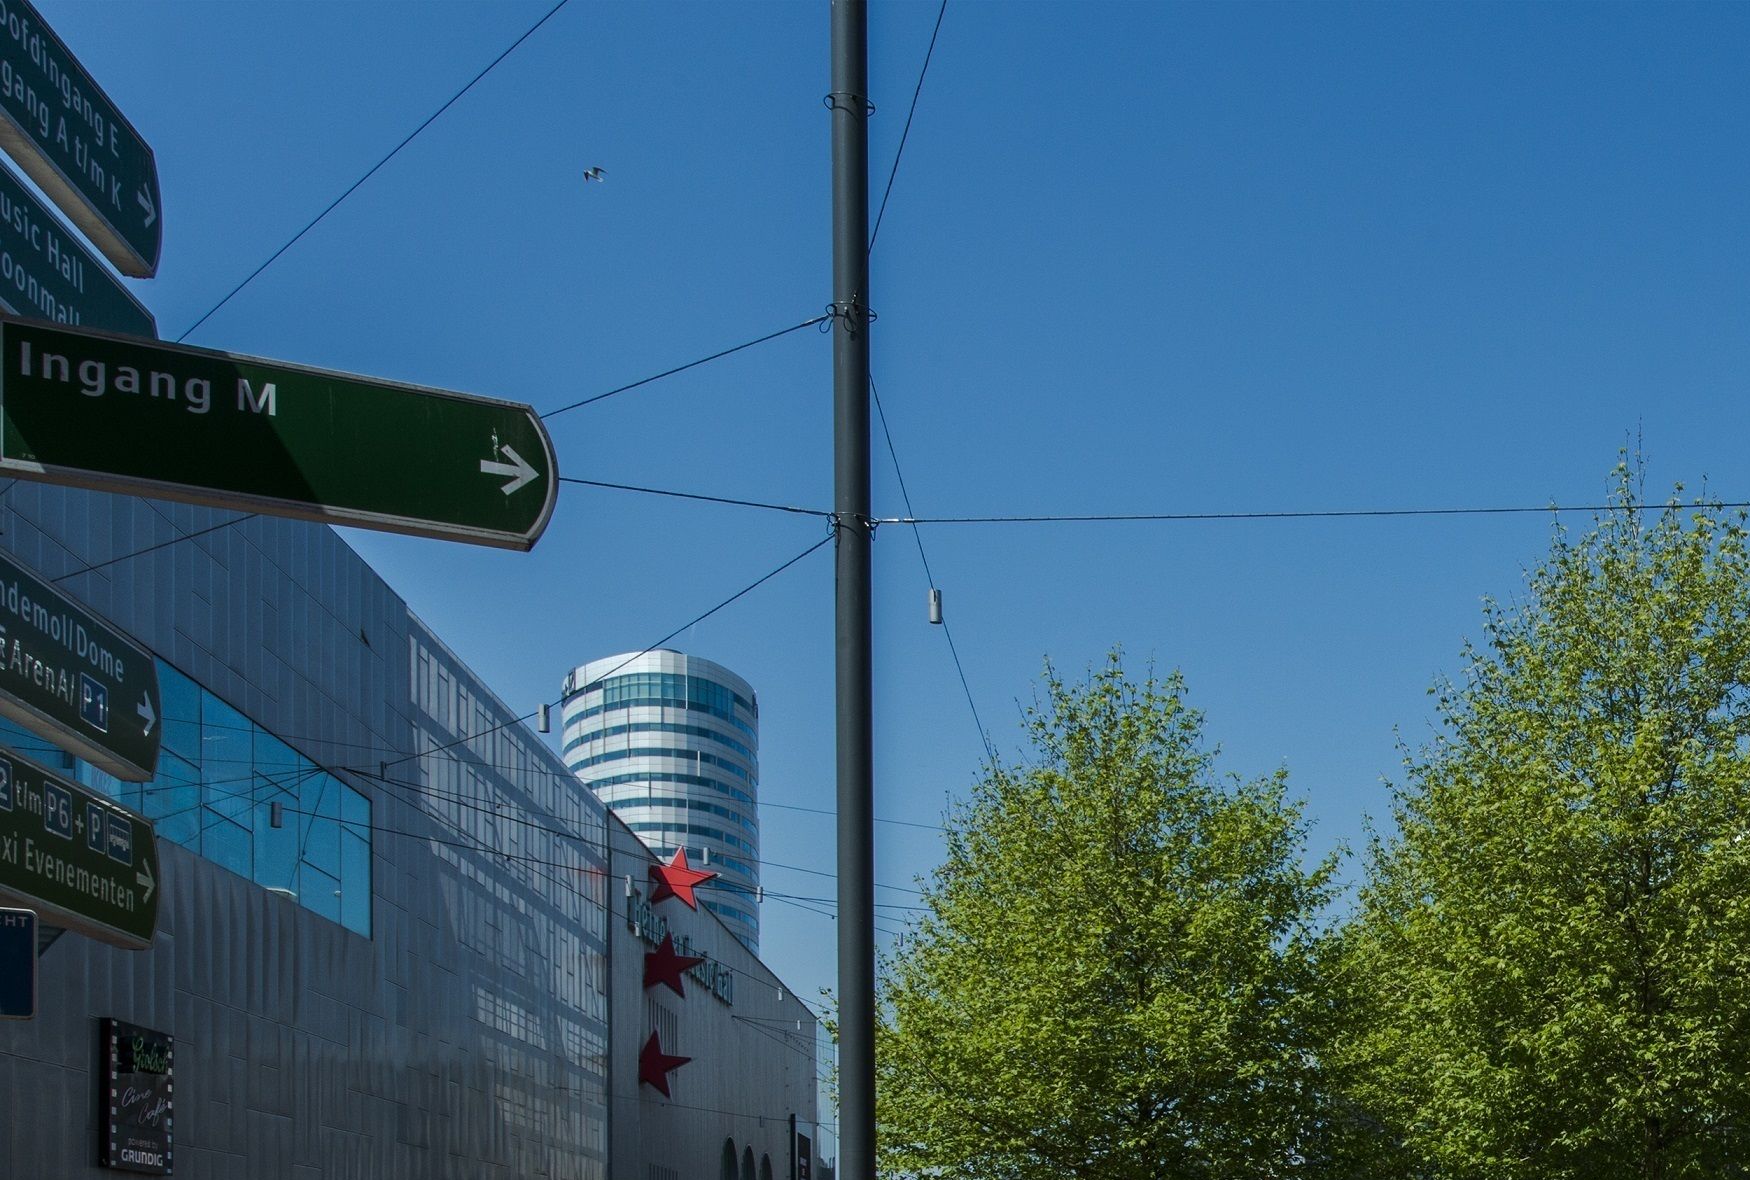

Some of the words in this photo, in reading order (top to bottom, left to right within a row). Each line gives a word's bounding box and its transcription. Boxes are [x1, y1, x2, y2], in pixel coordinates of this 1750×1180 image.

[2, 60, 49, 138] gang
[57, 115, 68, 152] A
[75, 136, 105, 192] t/m
[112, 176, 122, 212] K
[110, 123, 119, 158] E
[1, 192, 40, 251] usic
[48, 232, 83, 294] Hall
[21, 340, 210, 414] Ingang
[238, 378, 277, 416] M
[83, 683, 104, 723] P1
[16, 780, 42, 816] t/m
[47, 791, 69, 829] P6
[92, 813, 100, 841] P
[2, 831, 18, 865] xi
[25, 837, 134, 912] Evenementen
[0, 915, 27, 927] HT
